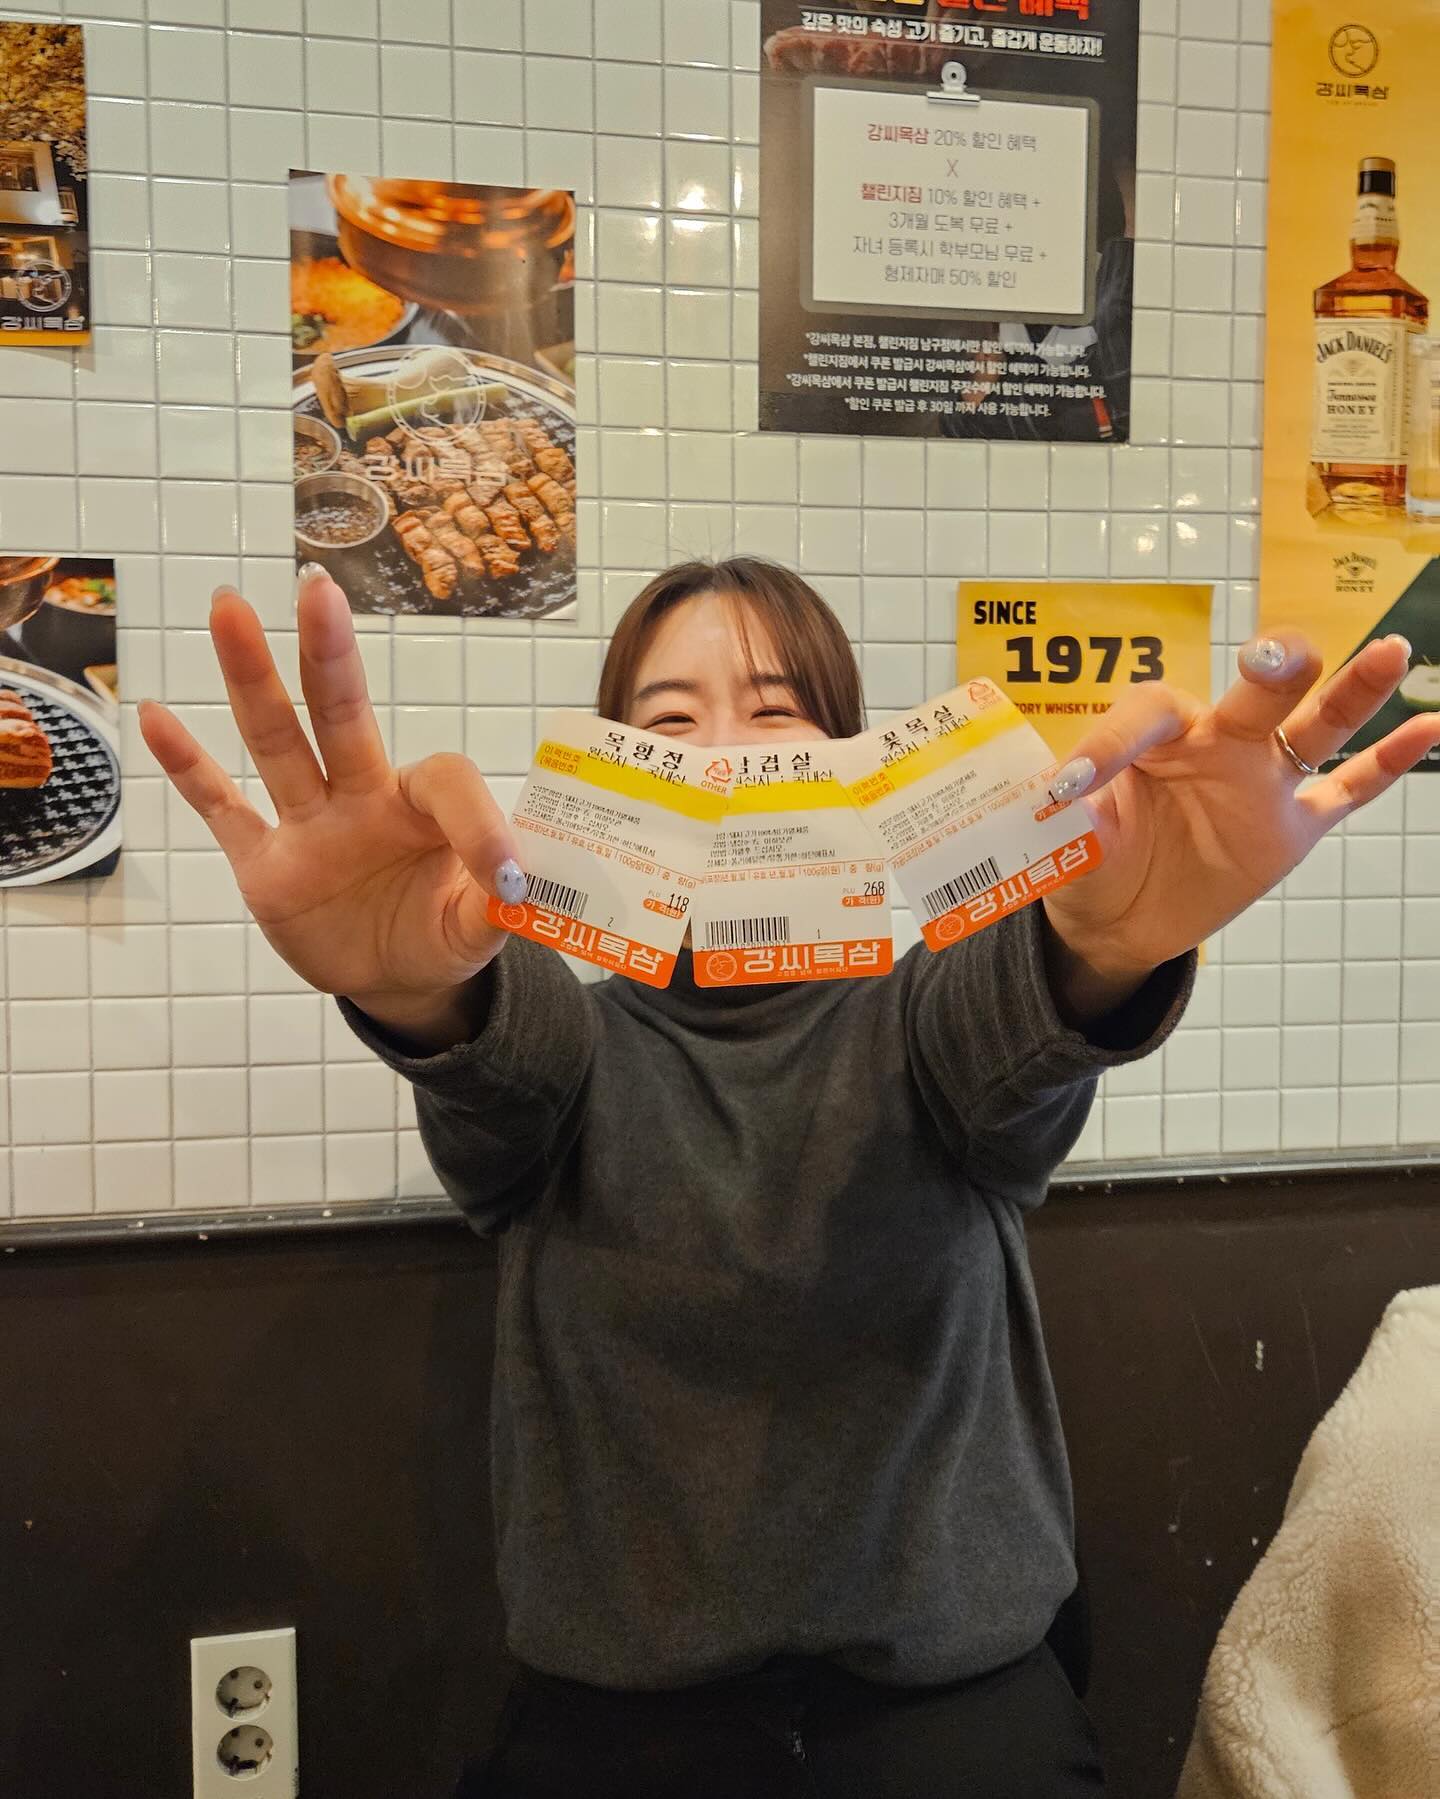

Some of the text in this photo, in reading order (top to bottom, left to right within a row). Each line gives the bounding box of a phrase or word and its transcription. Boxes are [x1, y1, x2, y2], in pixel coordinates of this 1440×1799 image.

[836, 14, 867, 36] 맛의
[870, 18, 902, 39] 숙성
[905, 20, 935, 42] 고기
[992, 27, 1035, 51] 즐겁게
[867, 123, 1037, 152] 강씨목삼 20% 할인 혜택
[928, 188, 958, 206] 10%
[963, 190, 993, 209] 할인
[998, 191, 1027, 210] 혜택
[889, 211, 929, 231] 3개월
[935, 214, 964, 233] 도복
[970, 216, 999, 235] 무료
[853, 235, 883, 255] 자녀
[888, 238, 934, 257] 등록시
[939, 240, 999, 262] 학부모님
[1004, 244, 1034, 263] 무료
[884, 264, 1017, 289] 형제자매 50% 할인
[1316, 337, 1345, 363] JACK
[870, 355, 891, 370] 쿠폰
[893, 357, 924, 371] 발급시
[986, 360, 1007, 375] 할인
[854, 375, 874, 390] 쿠폰
[876, 377, 907, 391] 발급시
[1002, 381, 1023, 396] 할인
[871, 398, 892, 411] 쿠폰
[894, 399, 915, 413] 발급
[917, 399, 928, 412] 후
[930, 400, 954, 414] 30일
[955, 401, 975, 414] 까지
[978, 401, 998, 415] 사용
[1327, 405, 1376, 415] HONEY
[974, 600, 1037, 625] SINCE
[1006, 635, 1164, 683] 1973
[1015, 703, 1041, 714] ORY
[1045, 703, 1088, 714] WHISKY
[587, 746, 627, 769] 원산지
[700, 780, 727, 795] OTHER
[792, 770, 832, 784] 국내산
[864, 881, 885, 897] 268
[964, 839, 1089, 922] 강씨목삼
[668, 892, 690, 914] 118
[607, 916, 614, 928] 2
[532, 909, 664, 976] 강씨목삼
[743, 941, 880, 973] 강씨목삼
